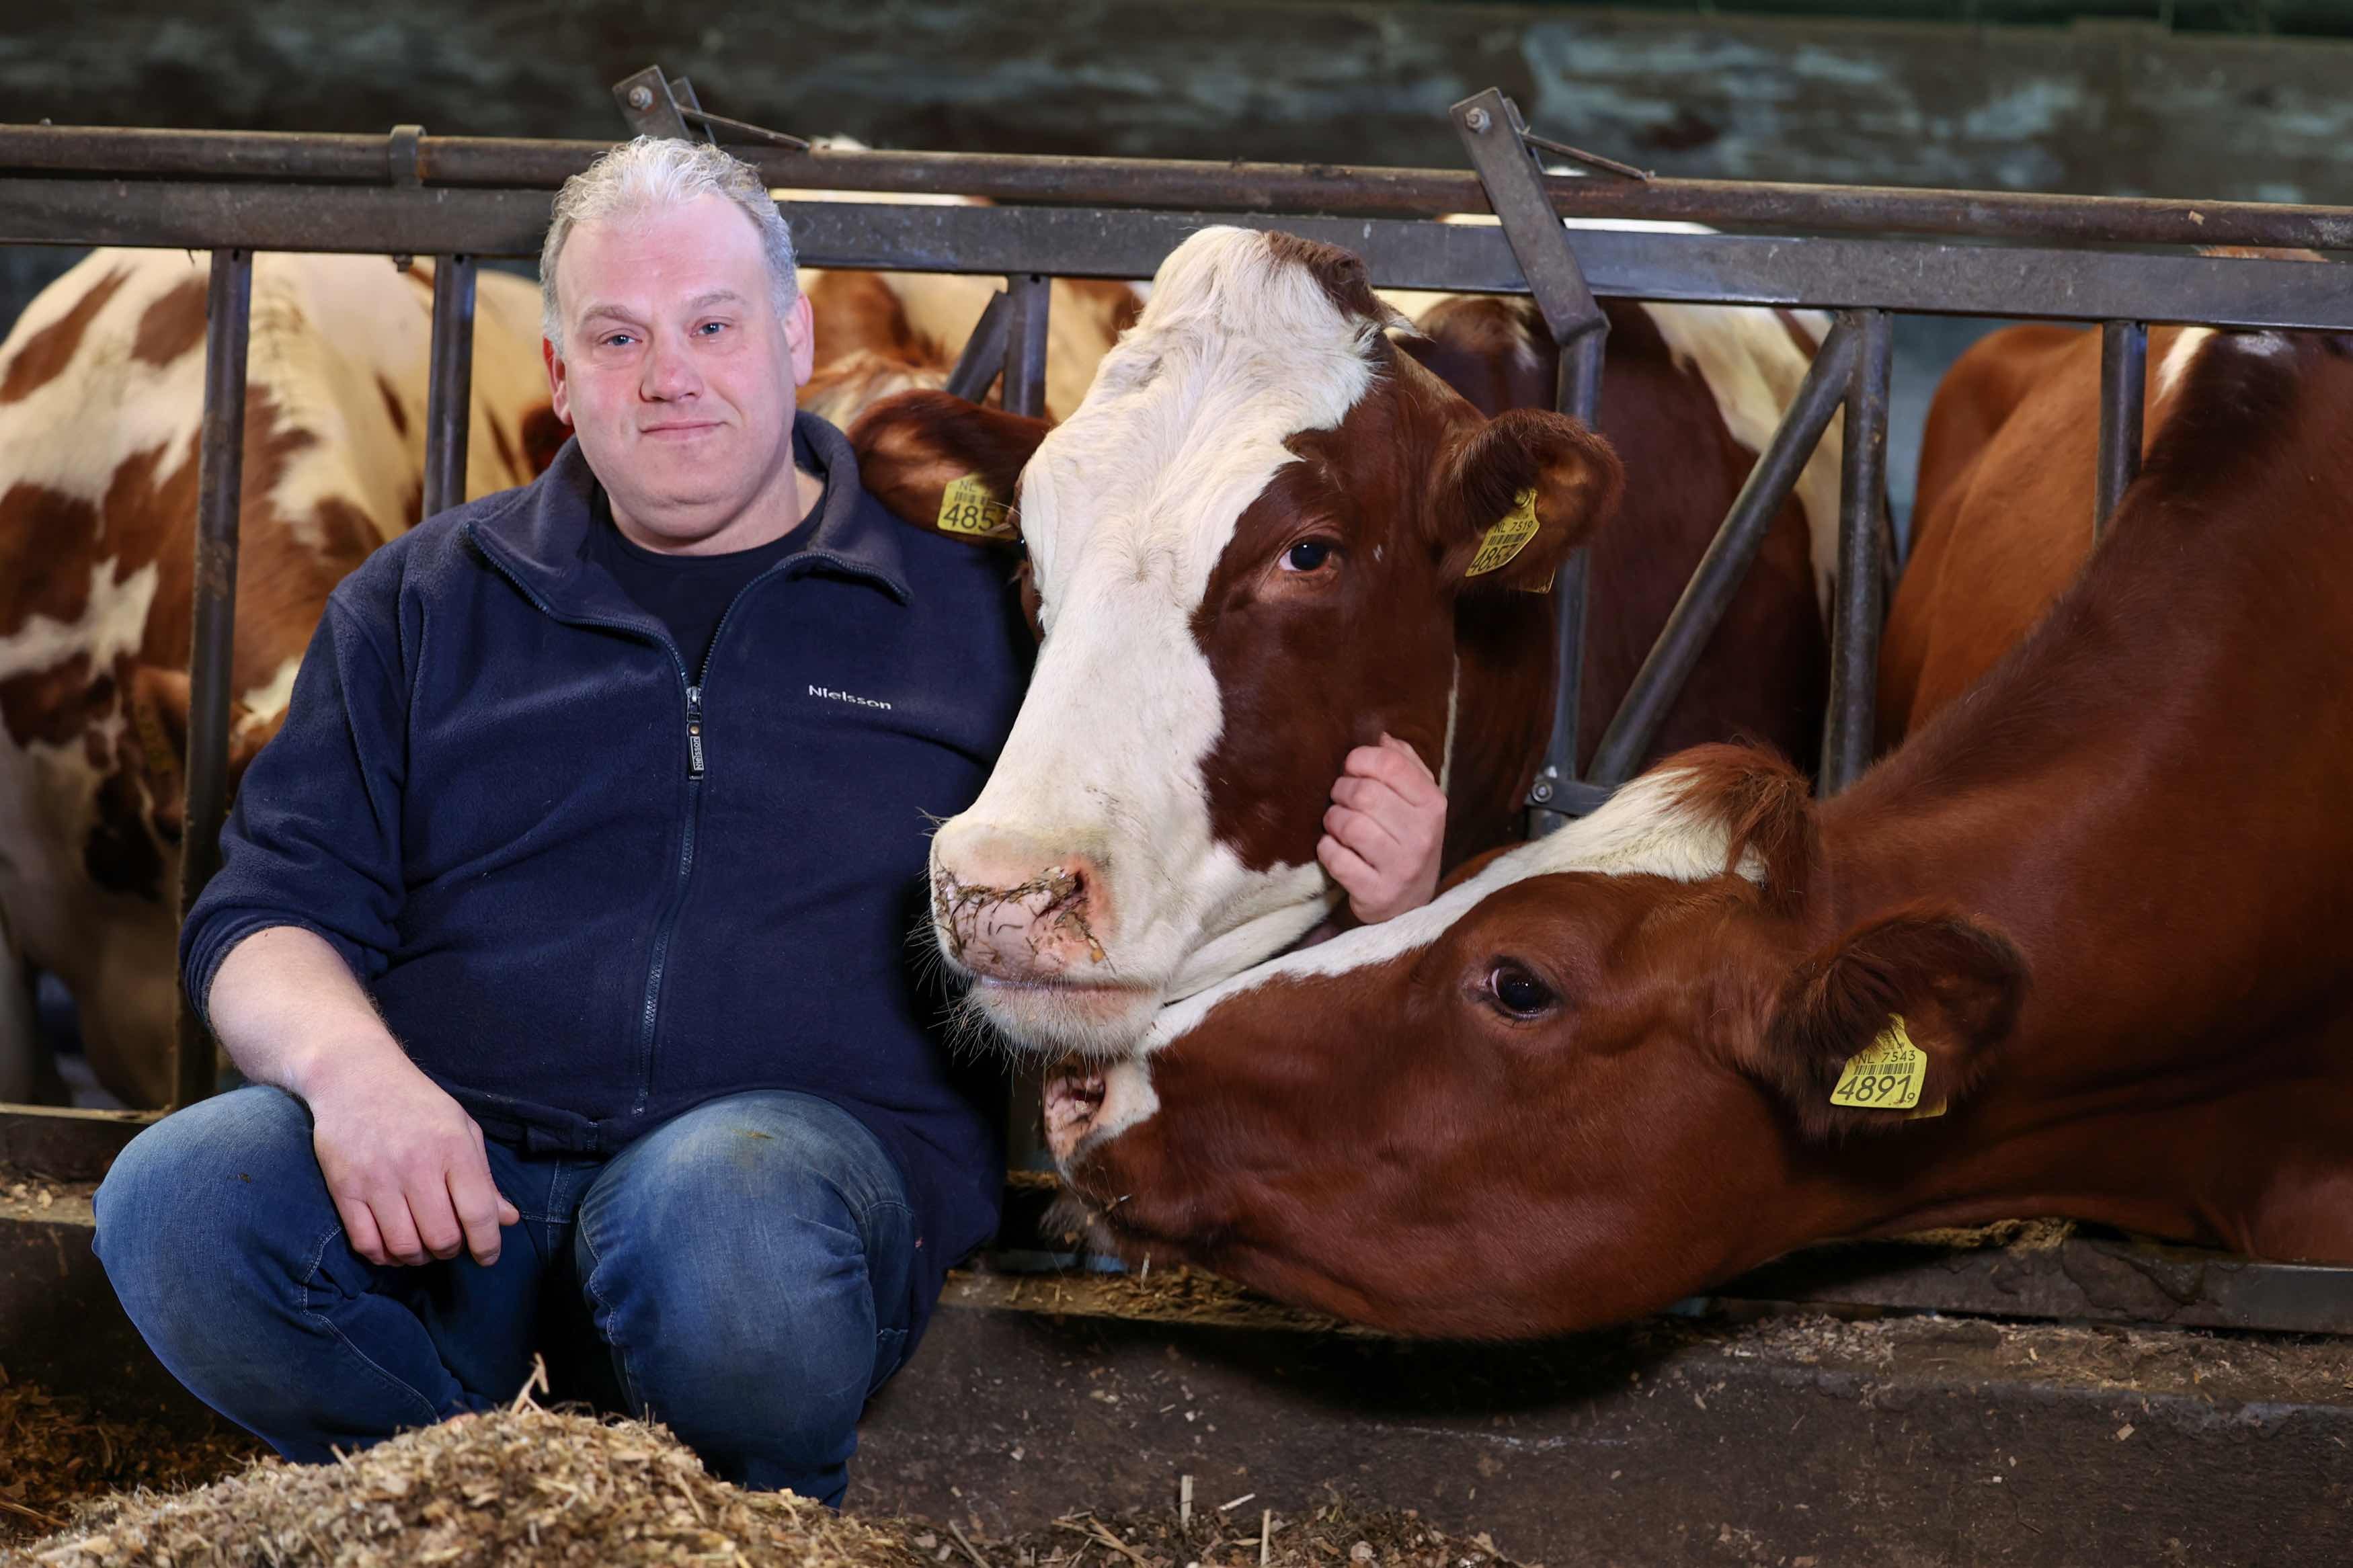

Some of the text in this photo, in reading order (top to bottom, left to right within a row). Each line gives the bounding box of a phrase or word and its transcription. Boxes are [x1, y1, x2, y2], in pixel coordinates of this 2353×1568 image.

[943, 503, 994, 532] 485
[1494, 522, 1505, 533] NL
[809, 684, 891, 710] Nielsson
[693, 737, 703, 770] Nielsson
[1858, 1050, 1915, 1064] NL 7543
